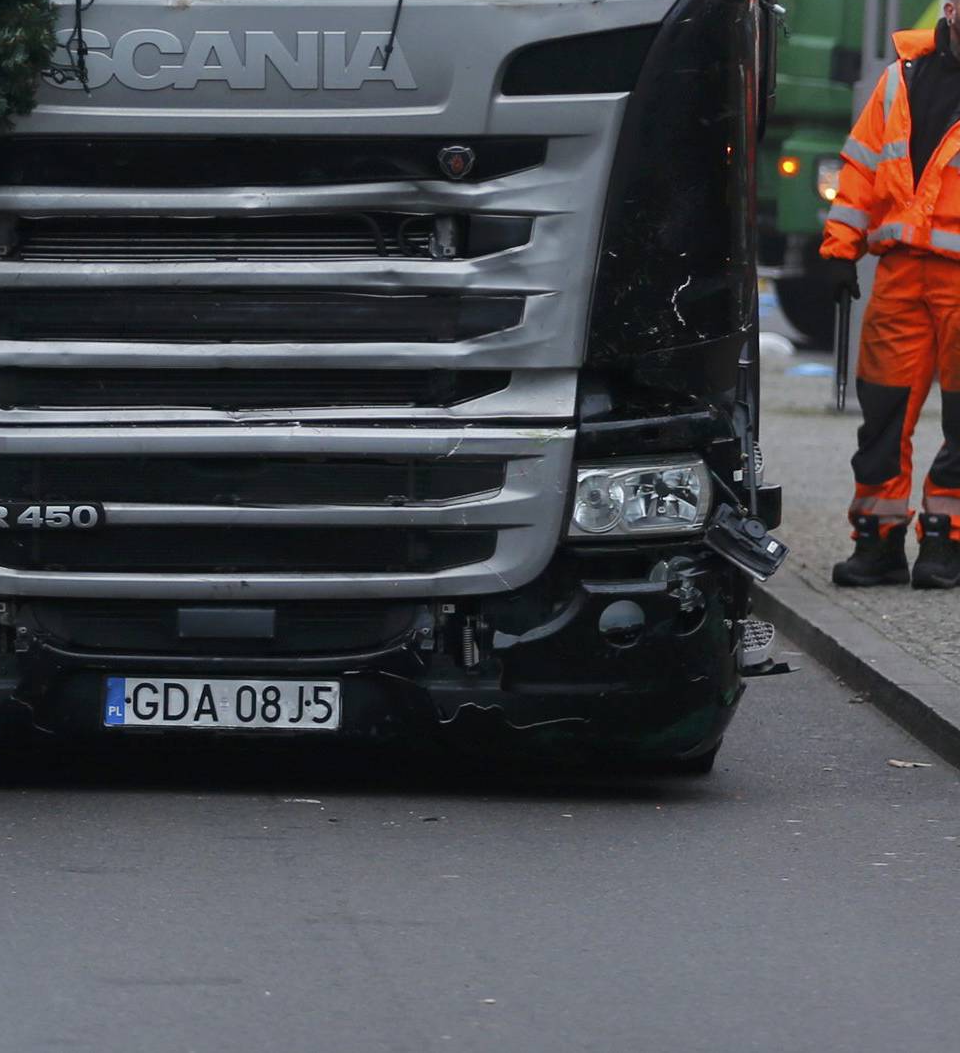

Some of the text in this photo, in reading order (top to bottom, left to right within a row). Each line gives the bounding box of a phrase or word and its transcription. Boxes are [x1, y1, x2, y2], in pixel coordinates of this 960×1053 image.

[42, 28, 418, 91] SCANIA
[17, 505, 98, 528] 450
[108, 706, 123, 717] PL
[132, 683, 219, 721] GDA
